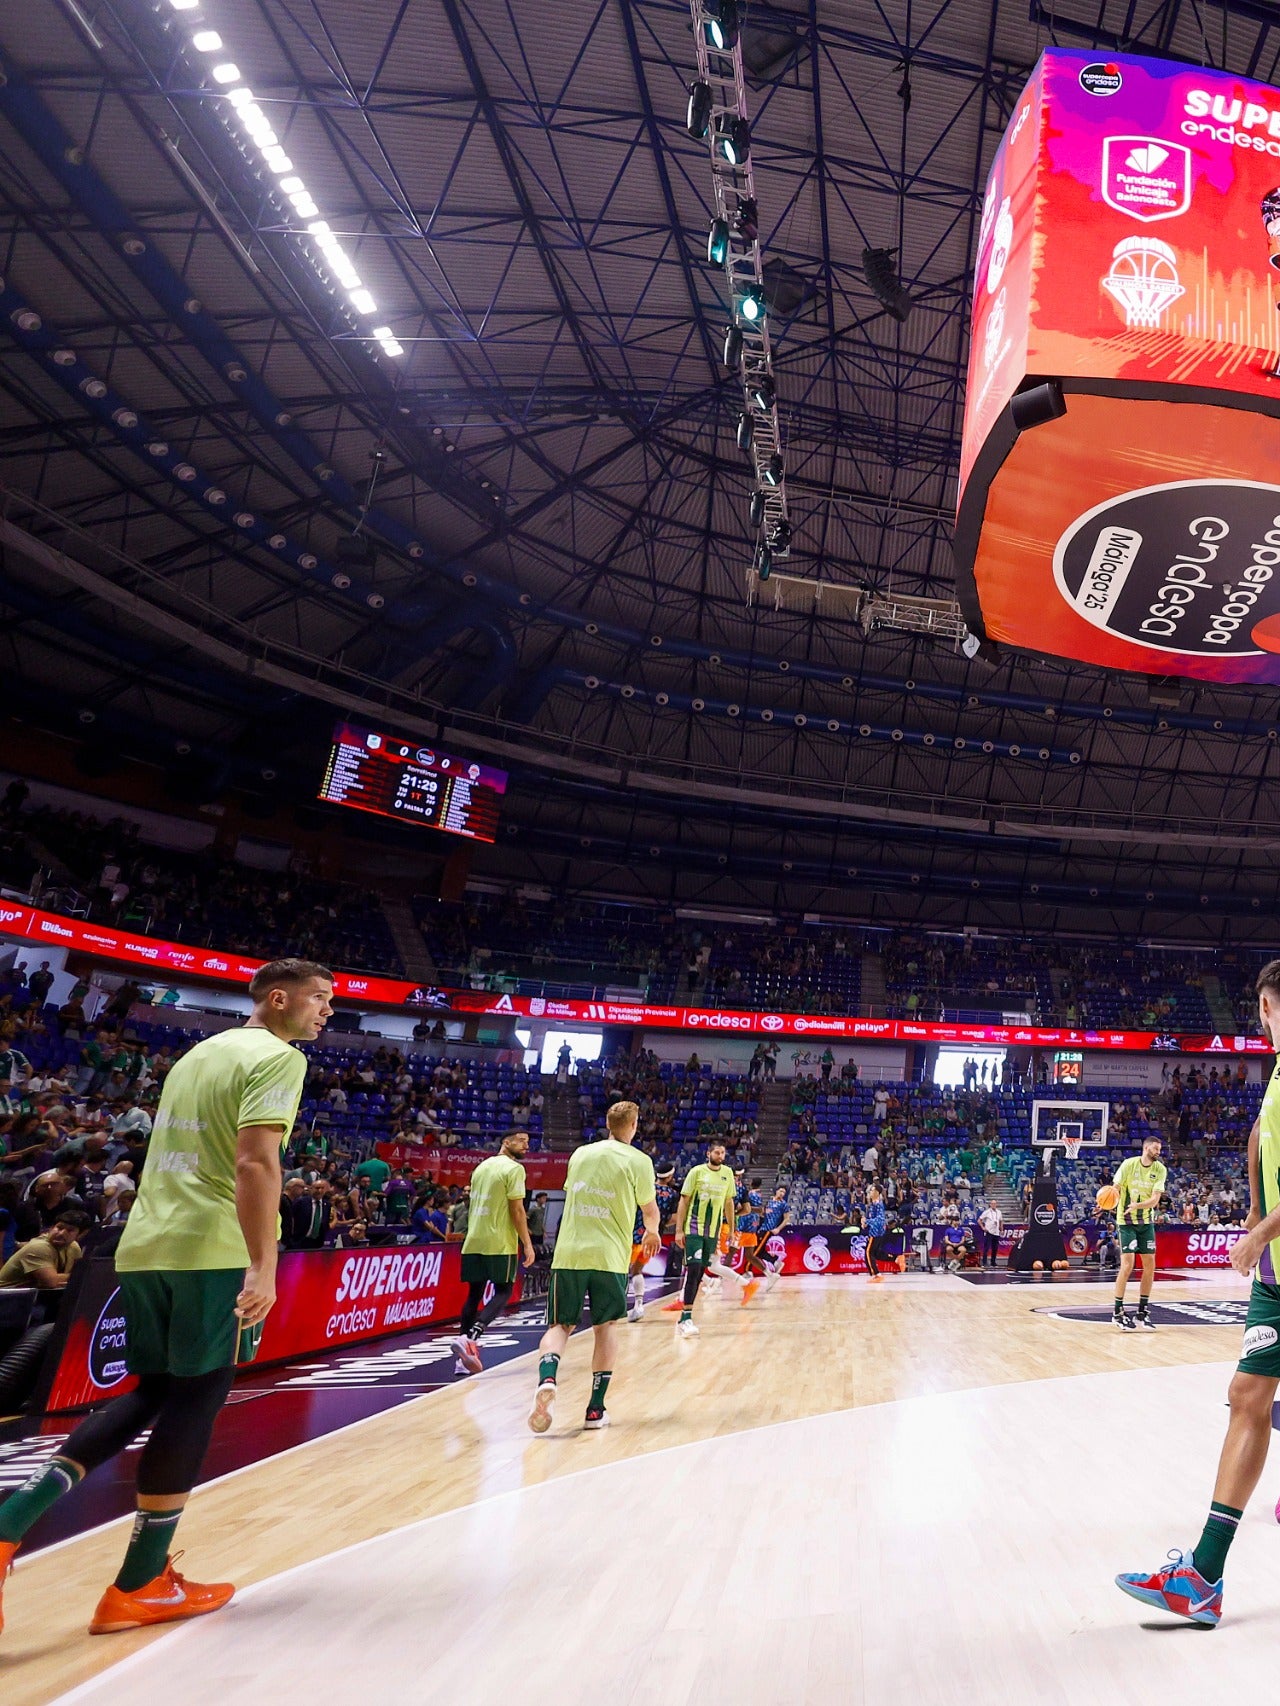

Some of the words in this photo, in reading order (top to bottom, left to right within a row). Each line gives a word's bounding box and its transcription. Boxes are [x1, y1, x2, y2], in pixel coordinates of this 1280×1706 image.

[1116, 173, 1176, 188] Fundación
[1125, 185, 1168, 199] Unicaja
[1116, 193, 1177, 207] Baloncesto
[1084, 532, 1133, 610] Málaga'25
[1139, 516, 1230, 638] endesa
[400, 746, 409, 757] 0
[441, 758, 450, 769] 0
[401, 774, 438, 793] 21:29
[395, 799, 402, 809] 0
[425, 807, 432, 817] 0
[41, 920, 73, 938] Wilson
[125, 943, 159, 955] KUMHO
[168, 951, 195, 962] renfe
[203, 961, 228, 972] LOTUS
[348, 980, 368, 990] UAX
[548, 1001, 569, 1010] Ciudad
[555, 1008, 577, 1017] Málaga
[608, 1006, 645, 1016] Diputación
[645, 1008, 677, 1017] Provincial
[617, 1013, 643, 1022] Málaga
[688, 1013, 751, 1029] endesa
[795, 1019, 846, 1031] mediolanum
[854, 1023, 884, 1034] pelayo
[1061, 1063, 1079, 1077] 24
[336, 1251, 443, 1302] SUPERCOPA
[383, 1297, 417, 1326] MÁLAGA
[417, 1297, 434, 1318] 2025
[326, 1305, 376, 1338] endesa
